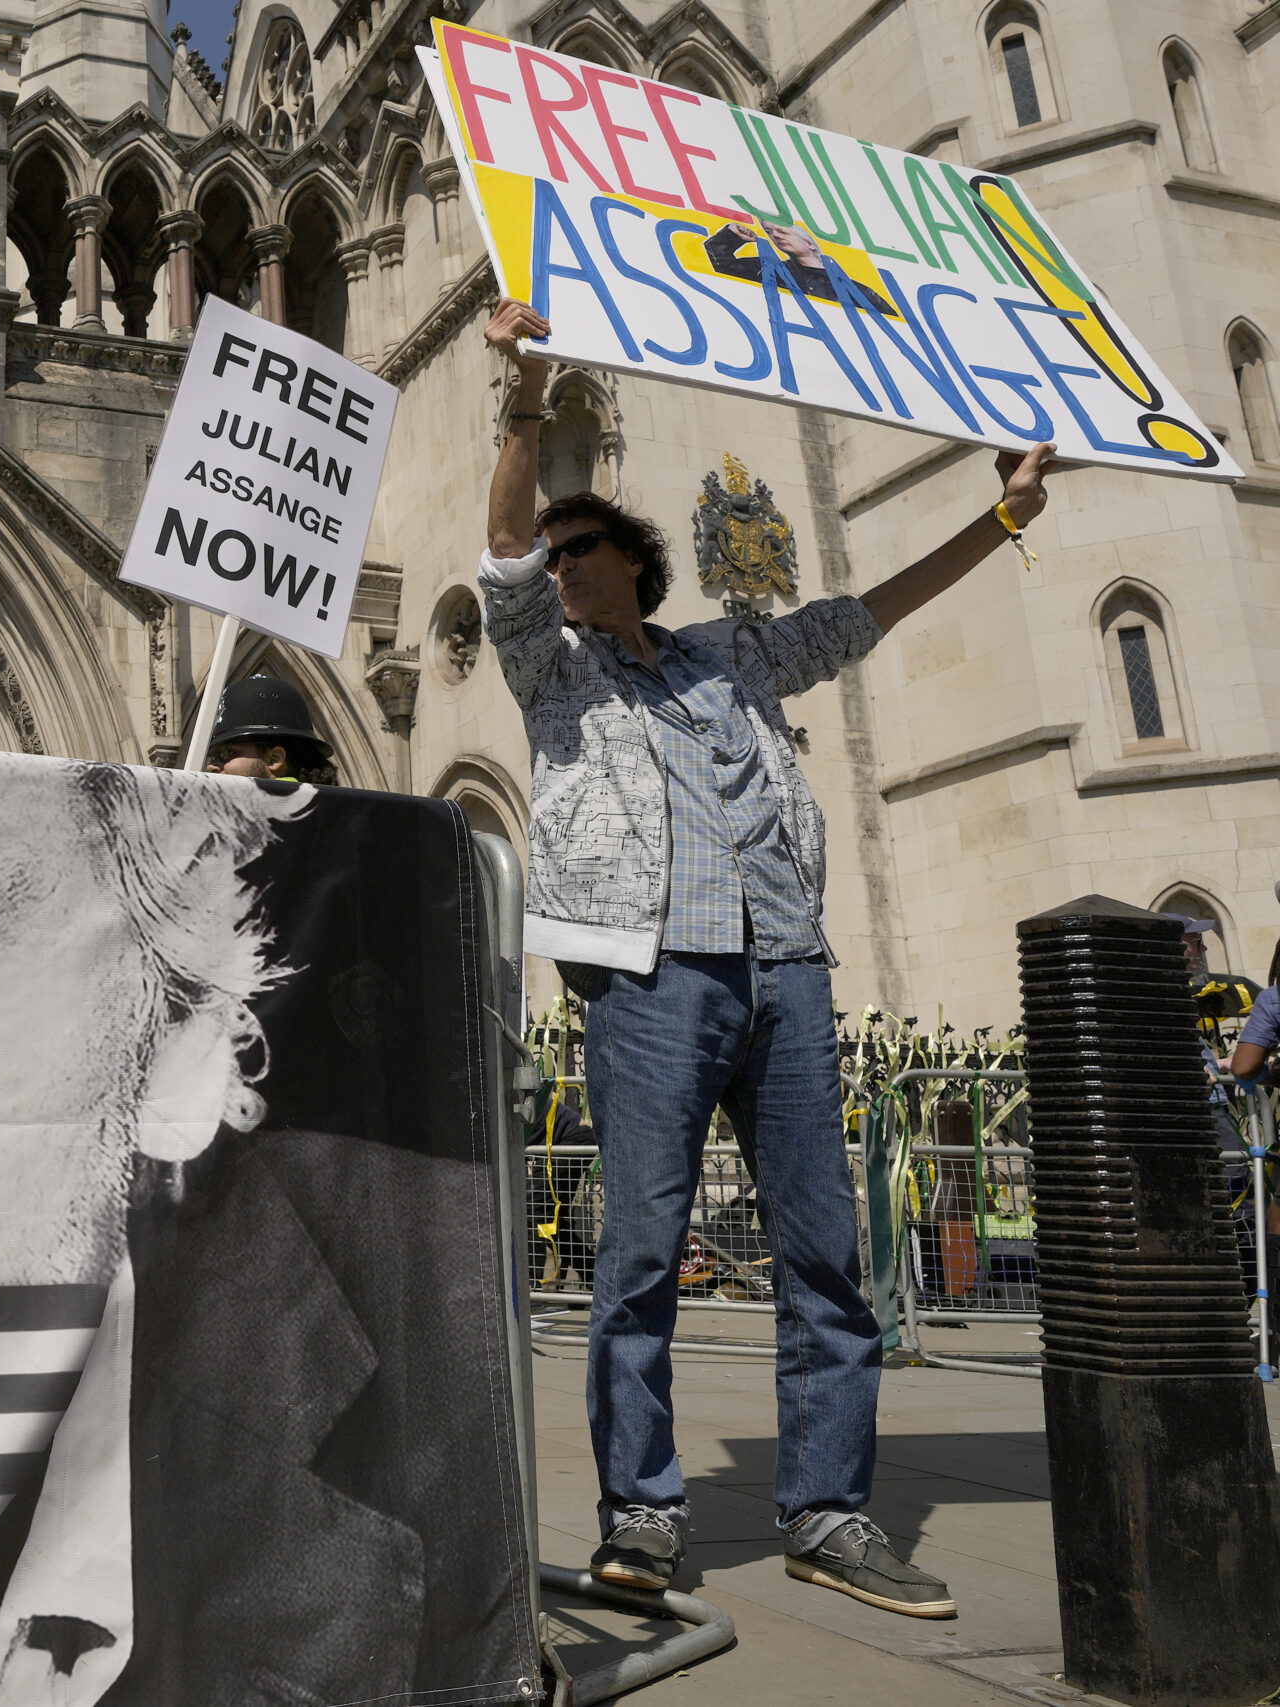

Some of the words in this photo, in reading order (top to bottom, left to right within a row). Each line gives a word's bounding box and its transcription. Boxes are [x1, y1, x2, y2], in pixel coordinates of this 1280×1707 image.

[442, 25, 755, 225] FREE
[729, 102, 1096, 303] JULIAN
[212, 331, 375, 445] FREE
[184, 459, 343, 545] ASSANGE
[201, 409, 353, 497] JULIAN
[154, 506, 337, 622] NOW!
